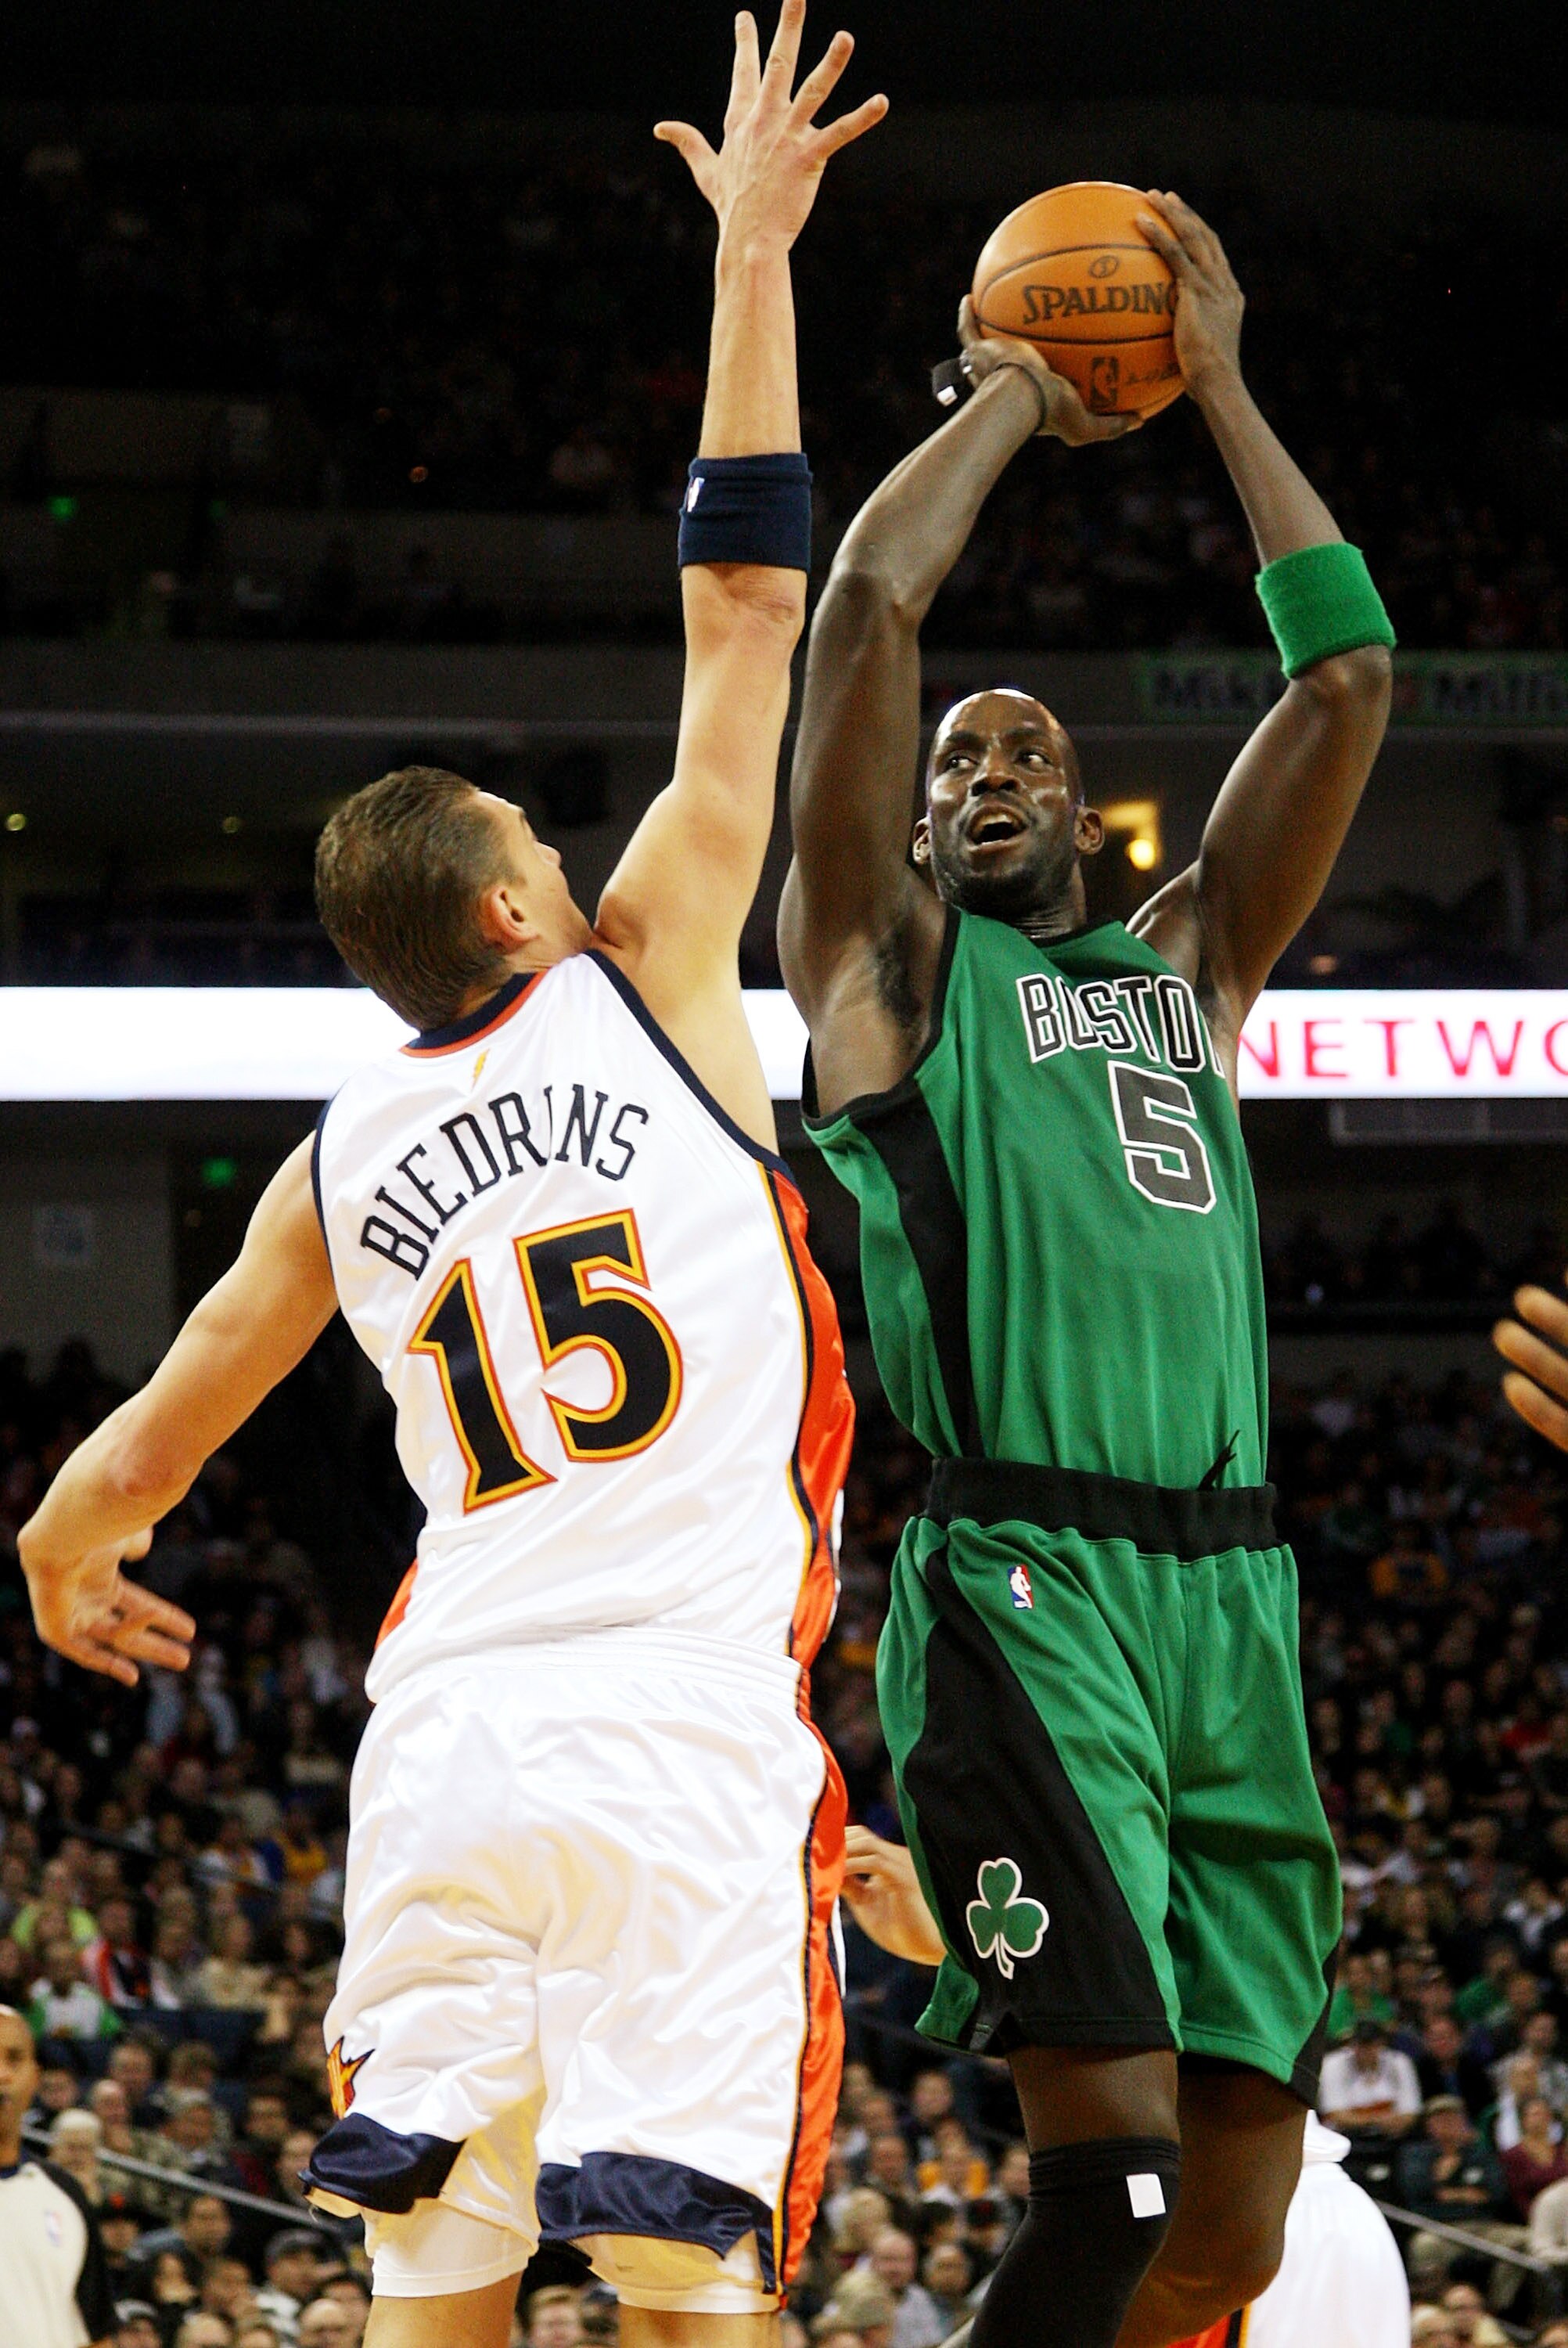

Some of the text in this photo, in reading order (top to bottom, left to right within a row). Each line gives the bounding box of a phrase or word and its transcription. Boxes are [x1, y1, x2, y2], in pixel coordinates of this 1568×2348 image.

[359, 1082, 649, 1280] BIEDRINS
[1107, 1060, 1216, 1214] 5
[406, 1207, 684, 1515] 15
